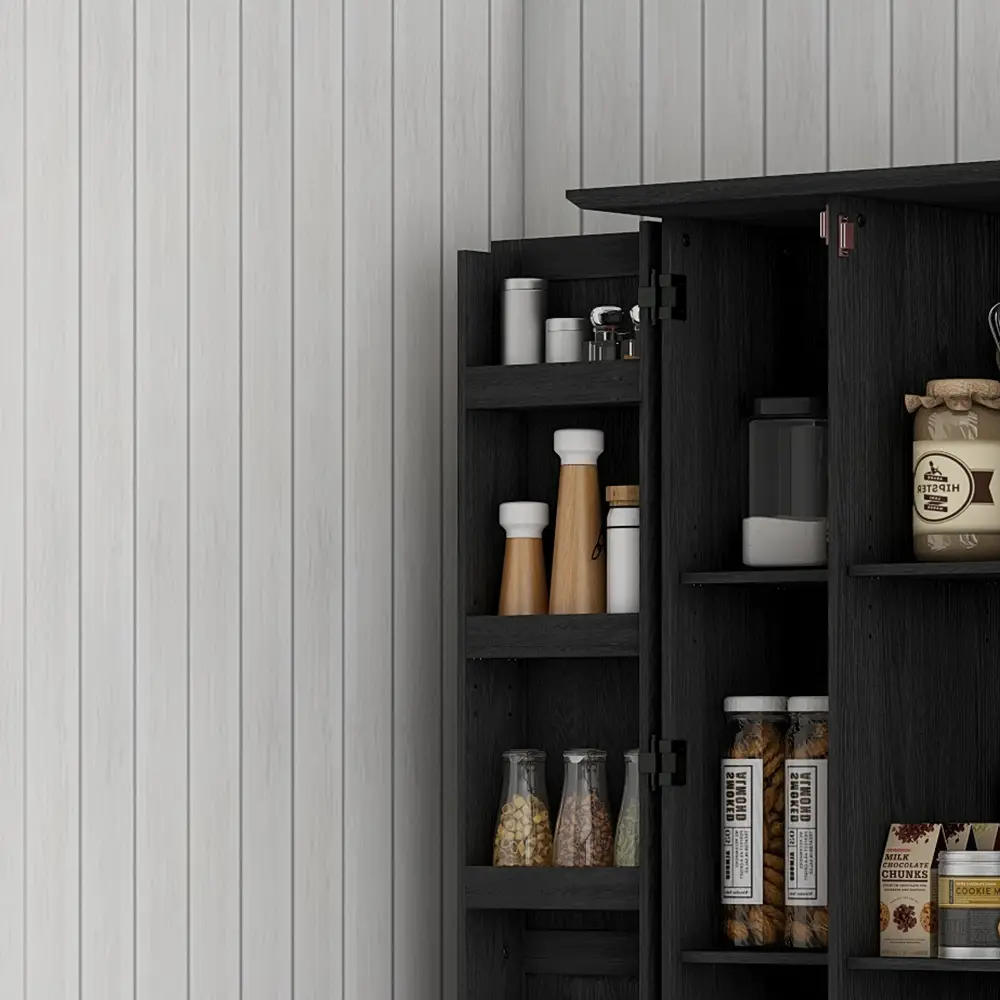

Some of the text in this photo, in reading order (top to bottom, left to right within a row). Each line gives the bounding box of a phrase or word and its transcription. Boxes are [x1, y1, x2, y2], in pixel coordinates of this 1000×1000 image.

[884, 853, 910, 861] MILK
[881, 870, 928, 879] CHUNKS
[956, 887, 991, 895] COOKIE
